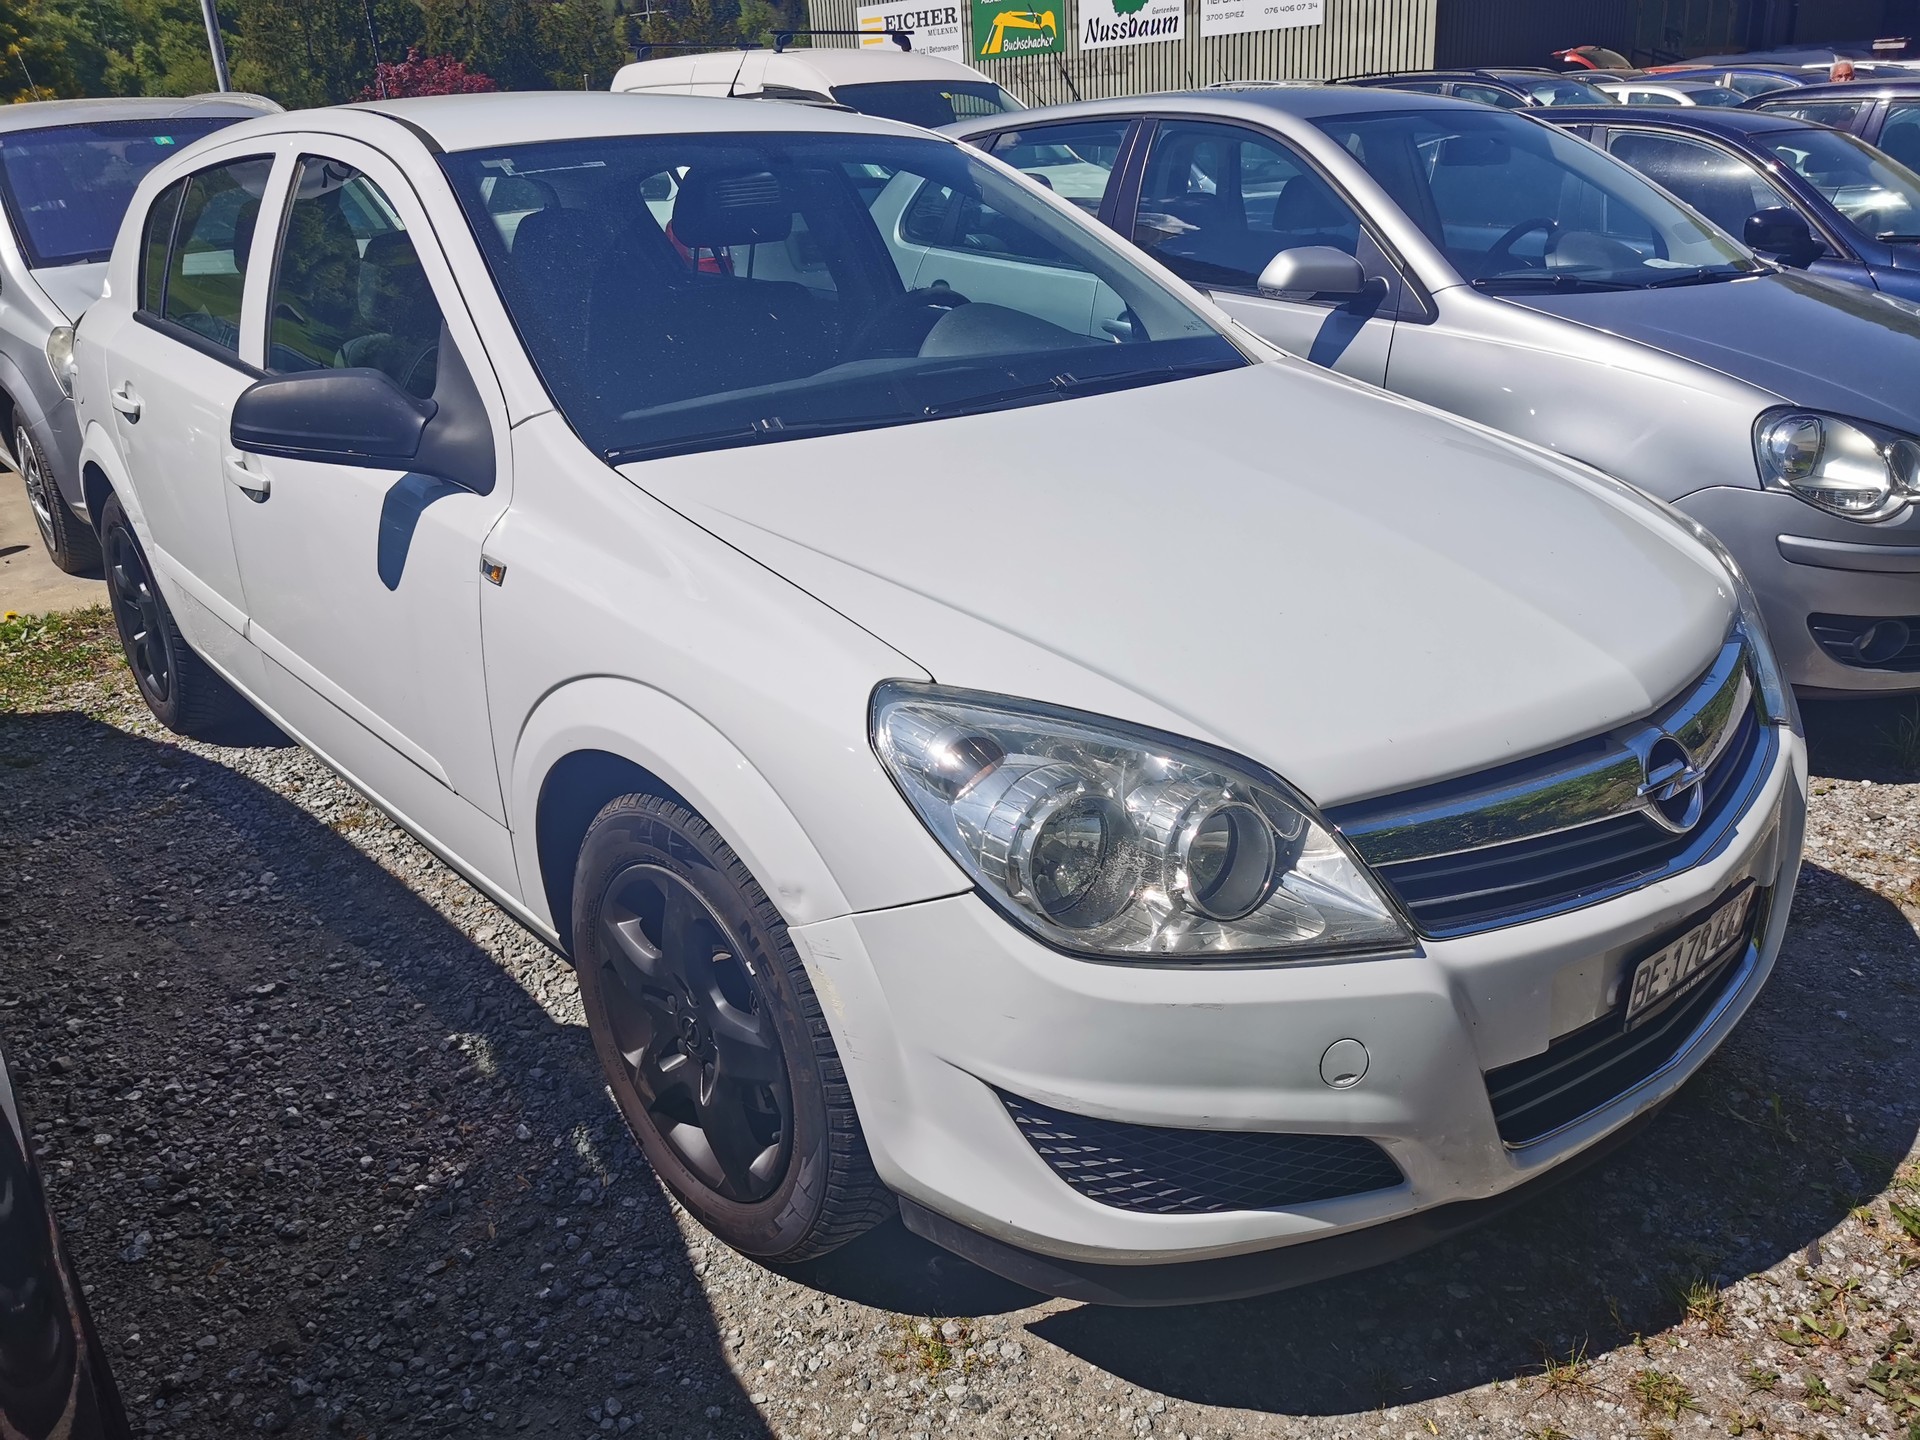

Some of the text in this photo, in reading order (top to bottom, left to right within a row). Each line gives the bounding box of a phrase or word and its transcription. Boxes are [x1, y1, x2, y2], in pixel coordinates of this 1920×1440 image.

[1151, 5, 1180, 15] Gartenbau
[1264, 2, 1318, 15] 076 406 07 34
[884, 7, 958, 31] EICHER
[1206, 10, 1245, 21] 3700 SPIEZ
[1084, 15, 1179, 44] Nussbaum
[929, 44, 960, 54] Betonwaren
[1003, 33, 1054, 52] Buchschacher
